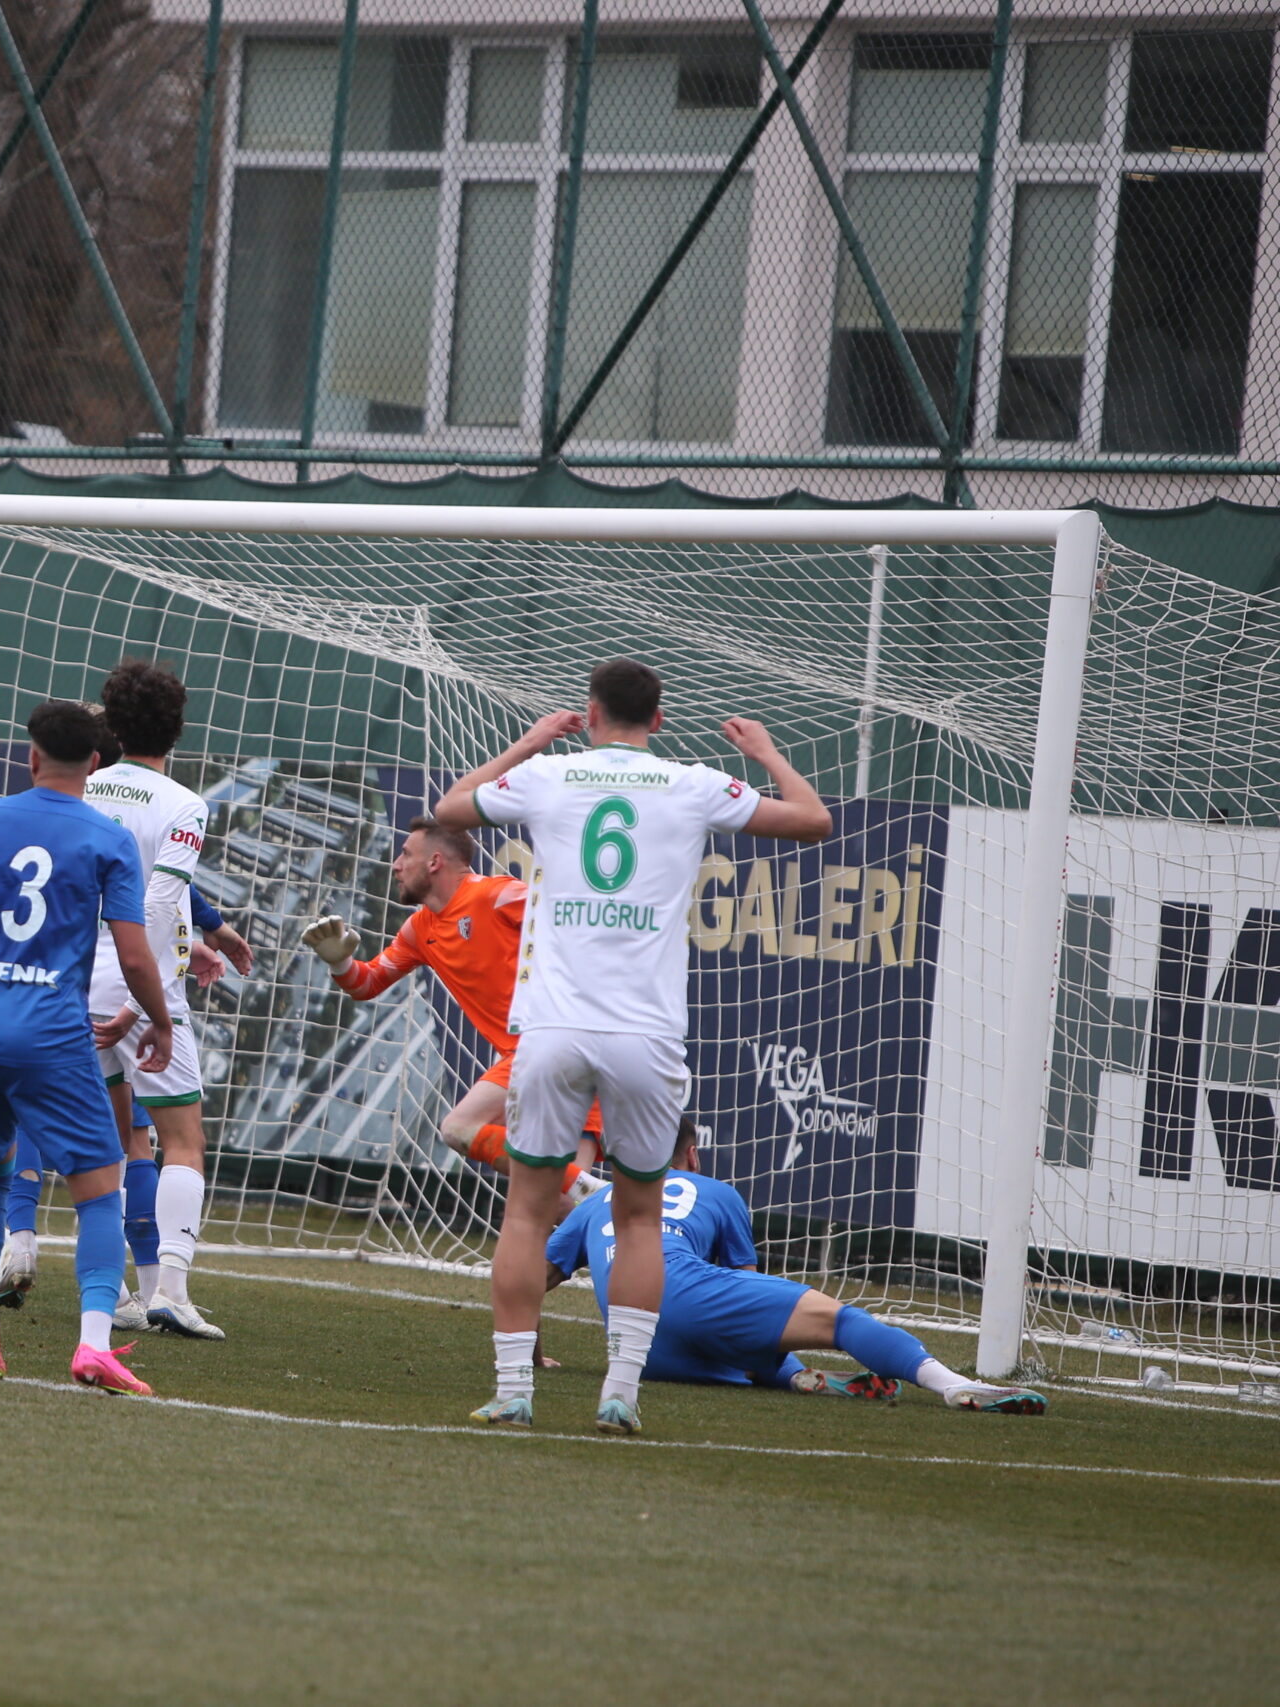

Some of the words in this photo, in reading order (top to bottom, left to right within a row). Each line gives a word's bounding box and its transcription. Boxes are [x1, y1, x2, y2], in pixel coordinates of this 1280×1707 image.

[84, 782, 154, 804] OWNTOWN
[564, 769, 670, 785] DOWNTOWN
[580, 794, 639, 894] 6
[0, 845, 53, 942] 3
[554, 897, 661, 932] ERTUĞRUL
[688, 843, 924, 968] GALERİ
[751, 1041, 827, 1097] VEGA
[801, 1109, 878, 1138] OTONOMİ
